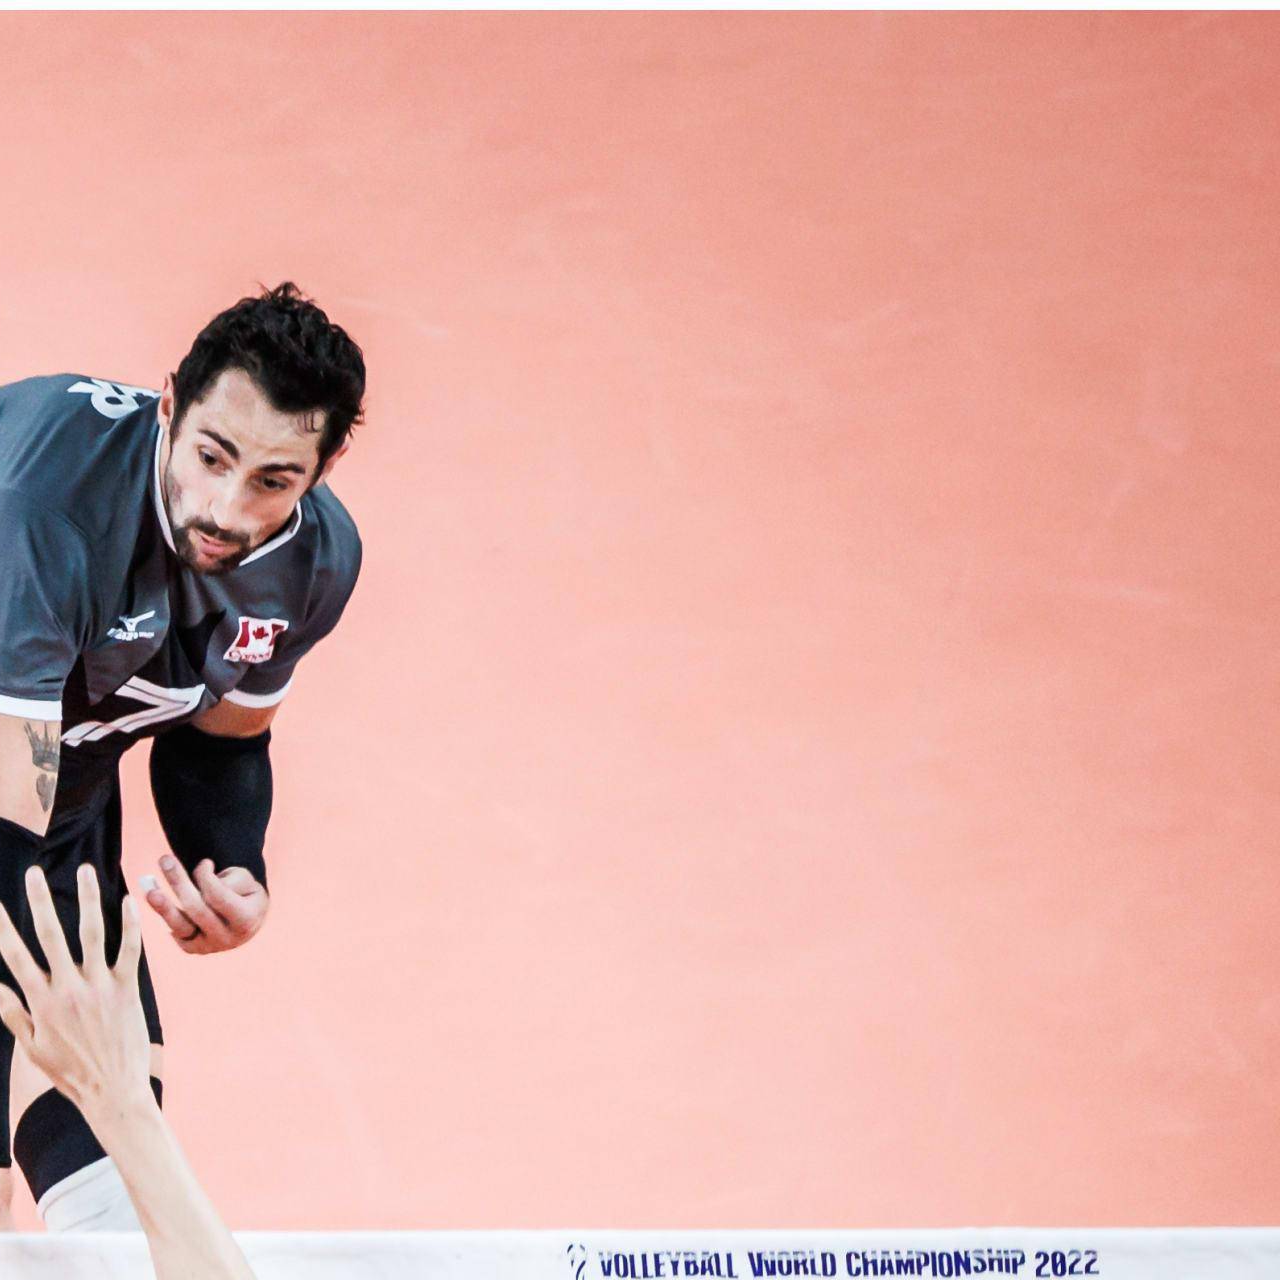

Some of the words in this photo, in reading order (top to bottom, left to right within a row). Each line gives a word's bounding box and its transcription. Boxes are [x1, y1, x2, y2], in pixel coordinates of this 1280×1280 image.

[60, 675, 205, 747] 7
[598, 1251, 738, 1280] VOLLEYBALL
[747, 1251, 837, 1278] WORLD
[845, 1249, 1026, 1279] CHAMPIONSHIP
[1034, 1249, 1100, 1276] 2022
